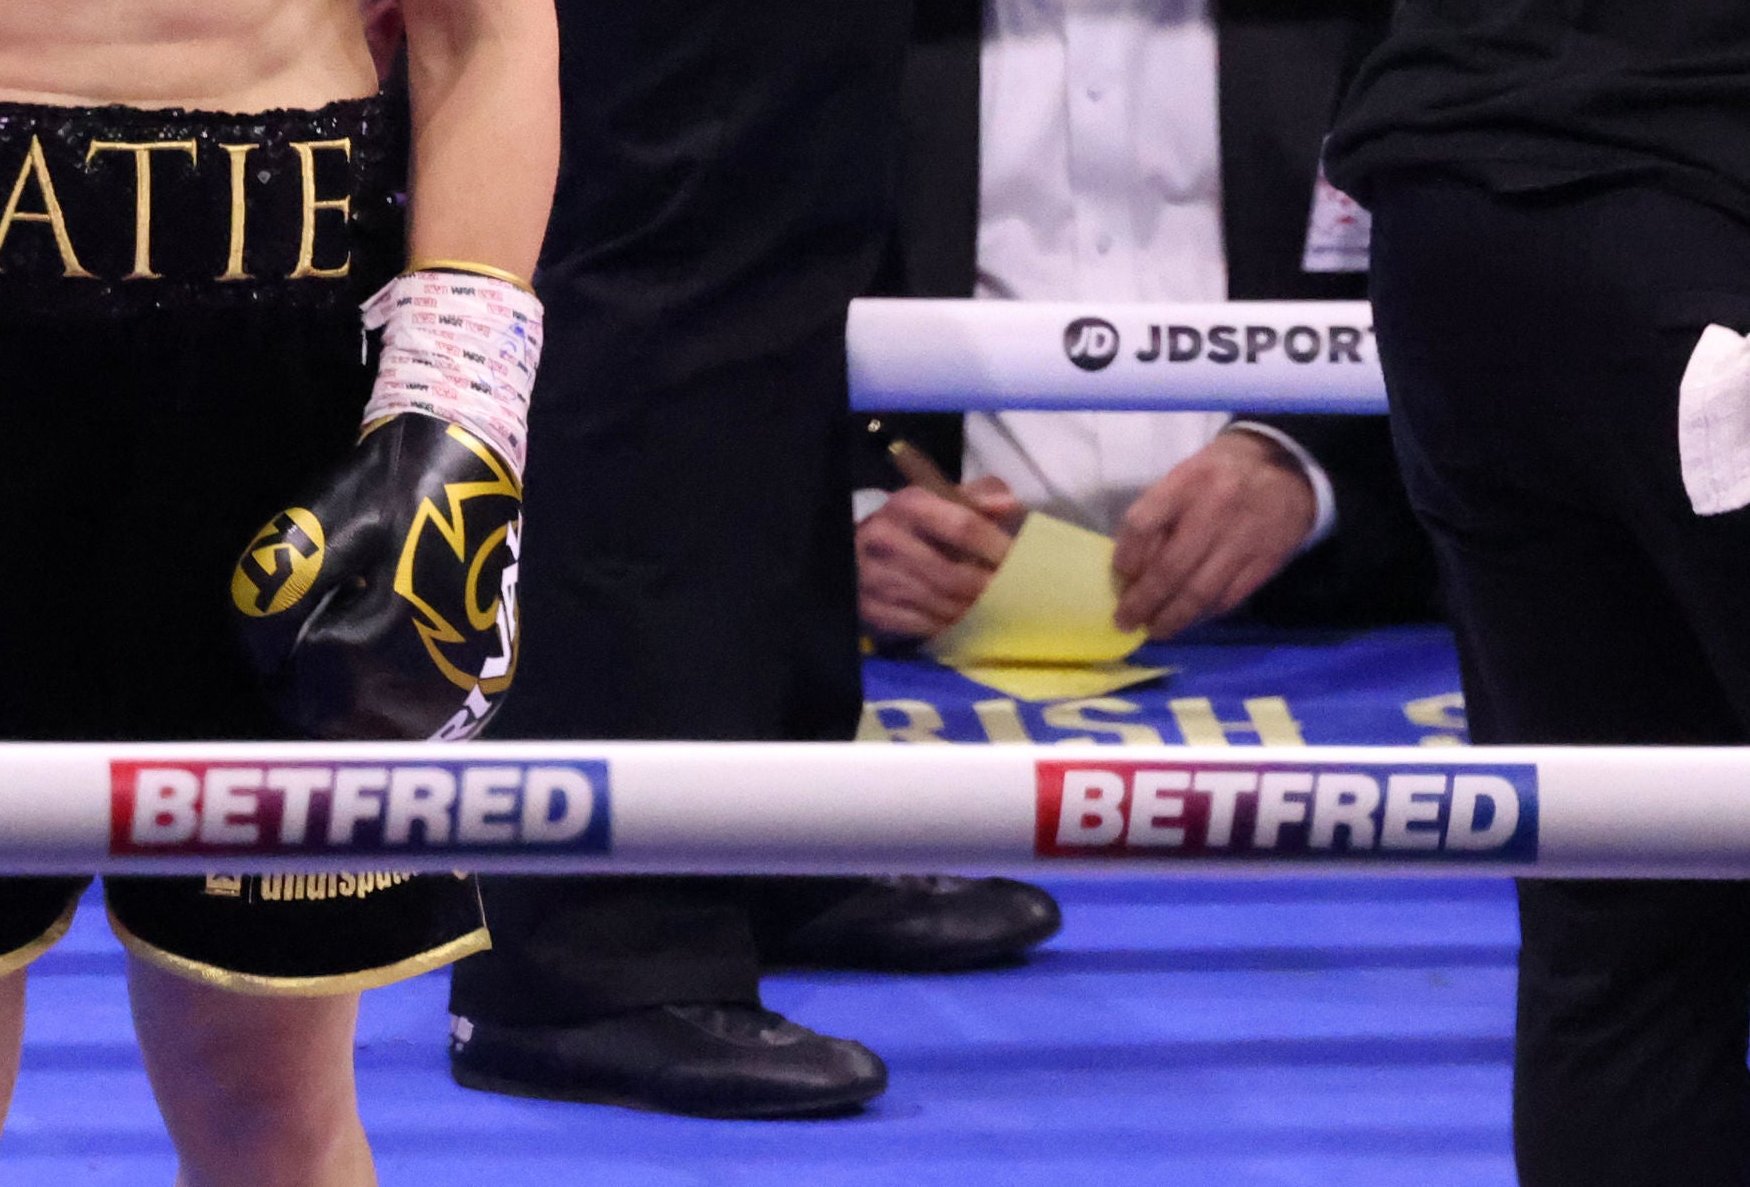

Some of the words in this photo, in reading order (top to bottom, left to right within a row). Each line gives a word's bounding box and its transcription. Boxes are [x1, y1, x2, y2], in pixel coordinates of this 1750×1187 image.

[1135, 324, 1376, 364] JDSPOR
[131, 768, 594, 844] BETFRED
[1056, 770, 1520, 850] BETFRED
